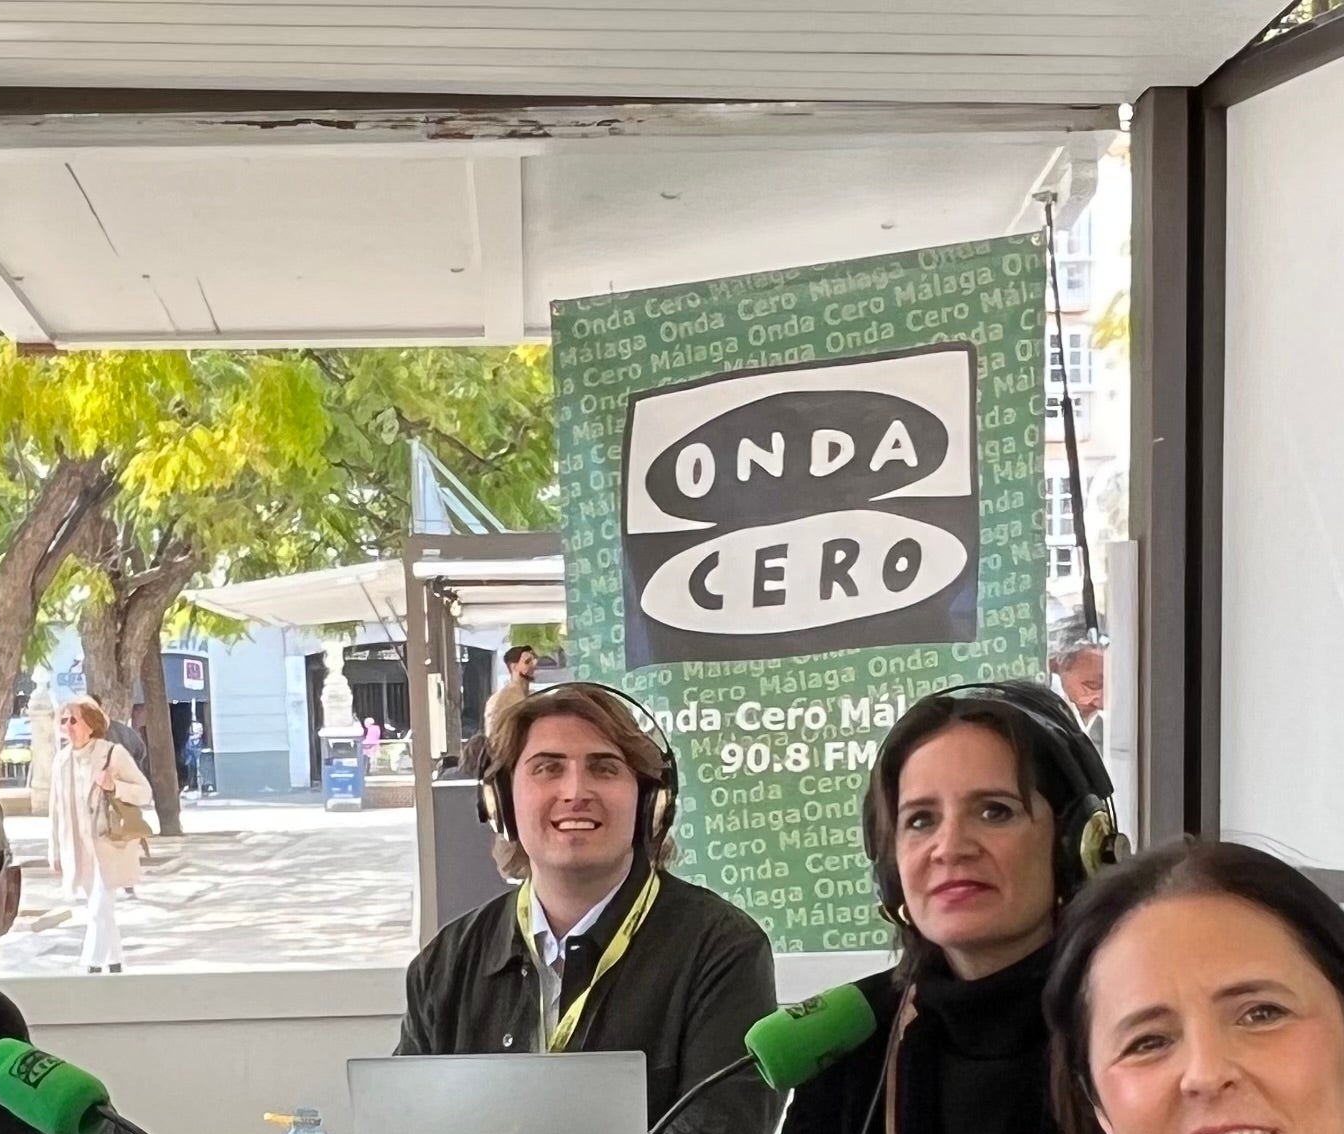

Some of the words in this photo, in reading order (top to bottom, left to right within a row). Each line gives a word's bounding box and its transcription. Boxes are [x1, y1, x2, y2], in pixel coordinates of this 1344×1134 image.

[558, 333, 648, 368] Málaga
[659, 311, 726, 343] Onda
[737, 291, 799, 322] Cero
[572, 308, 636, 340] Onda
[644, 291, 702, 319] Cero
[582, 362, 643, 389] Cero
[650, 335, 740, 376] Málaga
[748, 312, 817, 348] Onda
[823, 295, 886, 327] Cero
[894, 265, 996, 308] Málaga
[825, 320, 896, 354] Onda
[905, 302, 970, 333] Cero
[674, 419, 919, 499] ONDA
[688, 537, 924, 609] CERO
[621, 666, 673, 693] Cero
[759, 664, 857, 697] Málaga
[867, 648, 939, 678] Onda
[951, 636, 1007, 662] Cero
[735, 701, 828, 732] Cero
[840, 692, 908, 729] Mál
[720, 742, 811, 774] 90.8
[824, 740, 878, 772] FM
[710, 780, 783, 808] Onda
[798, 772, 863, 796] Cero
[707, 838, 767, 861] Cero
[778, 824, 863, 852] Málag
[720, 858, 790, 886] Onda
[724, 886, 804, 910] álaga
[814, 871, 874, 899] Ond
[822, 927, 889, 951] Cero
